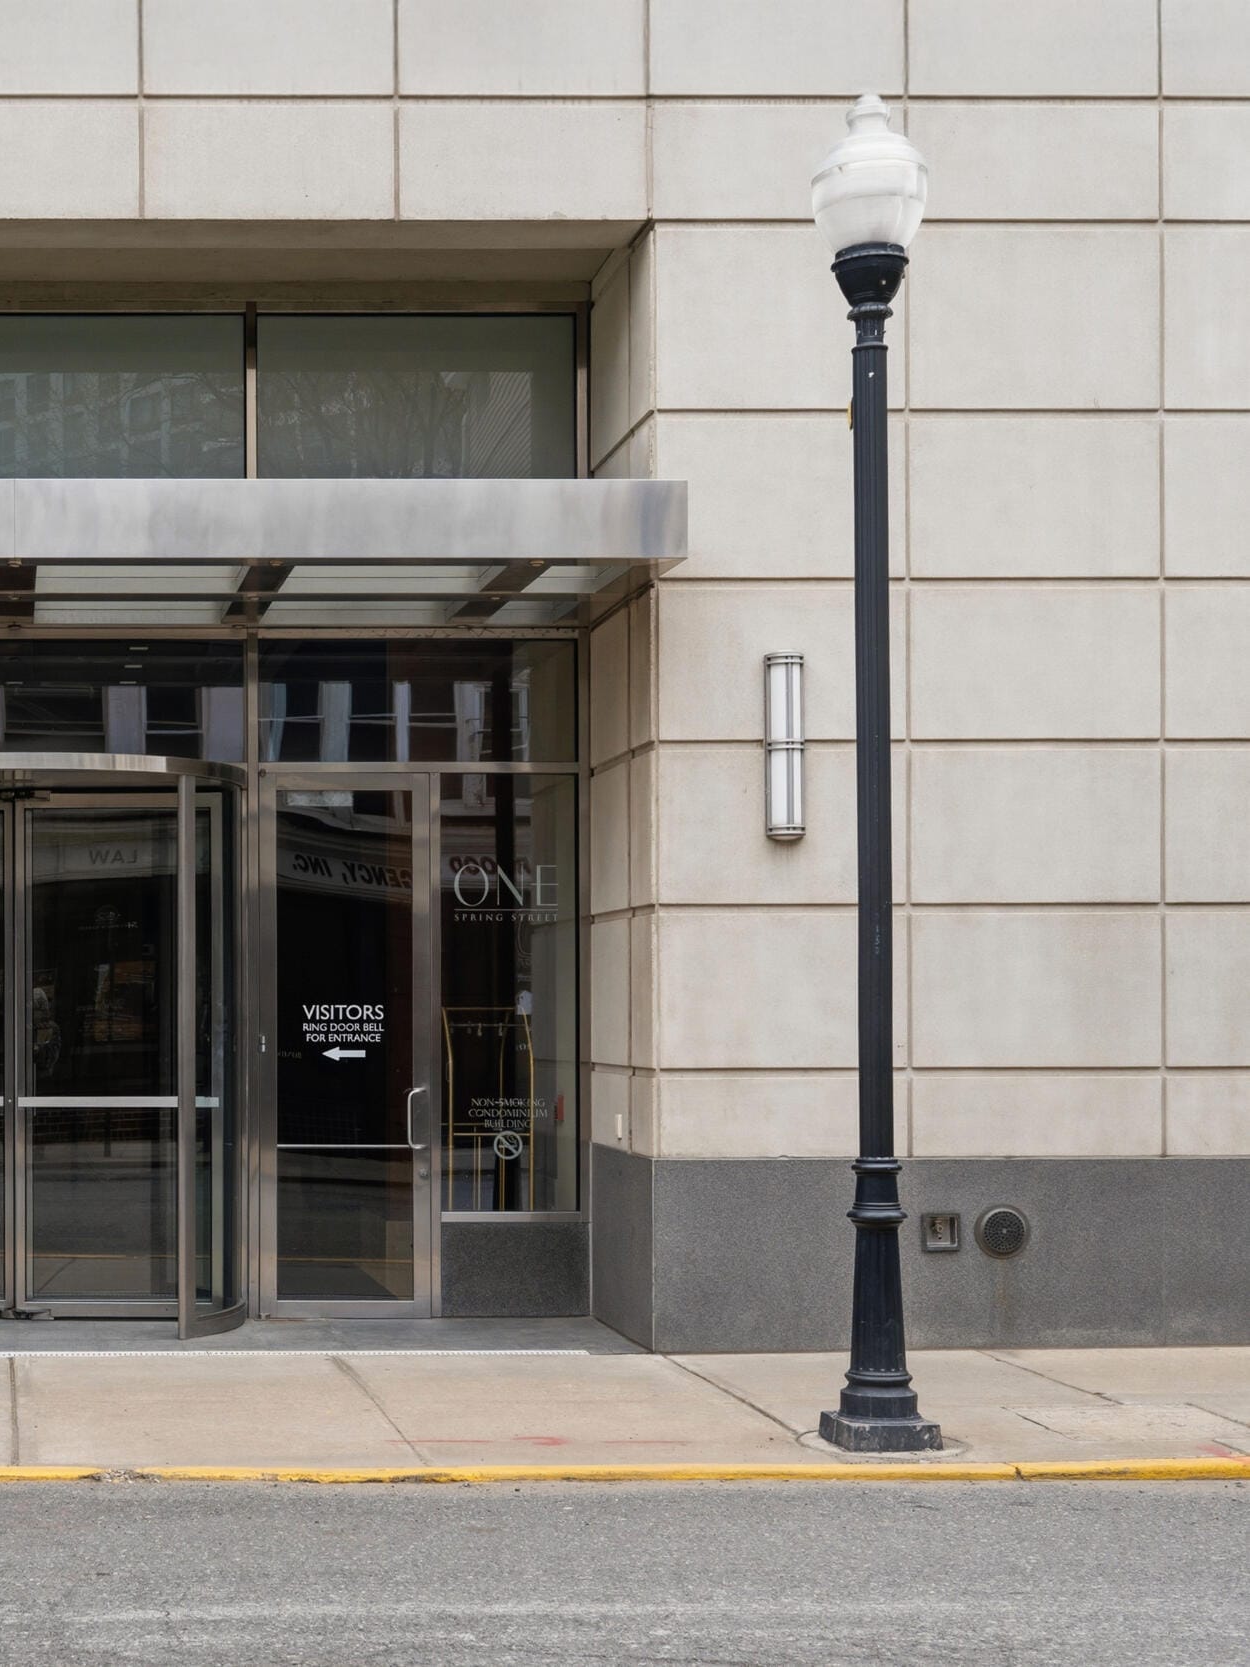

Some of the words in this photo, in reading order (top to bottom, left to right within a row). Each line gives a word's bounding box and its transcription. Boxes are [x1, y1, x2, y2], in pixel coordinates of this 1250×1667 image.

[453, 863, 559, 907] ONE
[454, 913, 503, 922] SPRING
[511, 913, 558, 922] STREET
[302, 1004, 385, 1021] VISITORS
[302, 1022, 328, 1032] RING
[329, 1022, 361, 1032] DOOR
[362, 1022, 385, 1032] BELL
[305, 1033, 327, 1043] FOR
[328, 1033, 382, 1043] ENTRANCE
